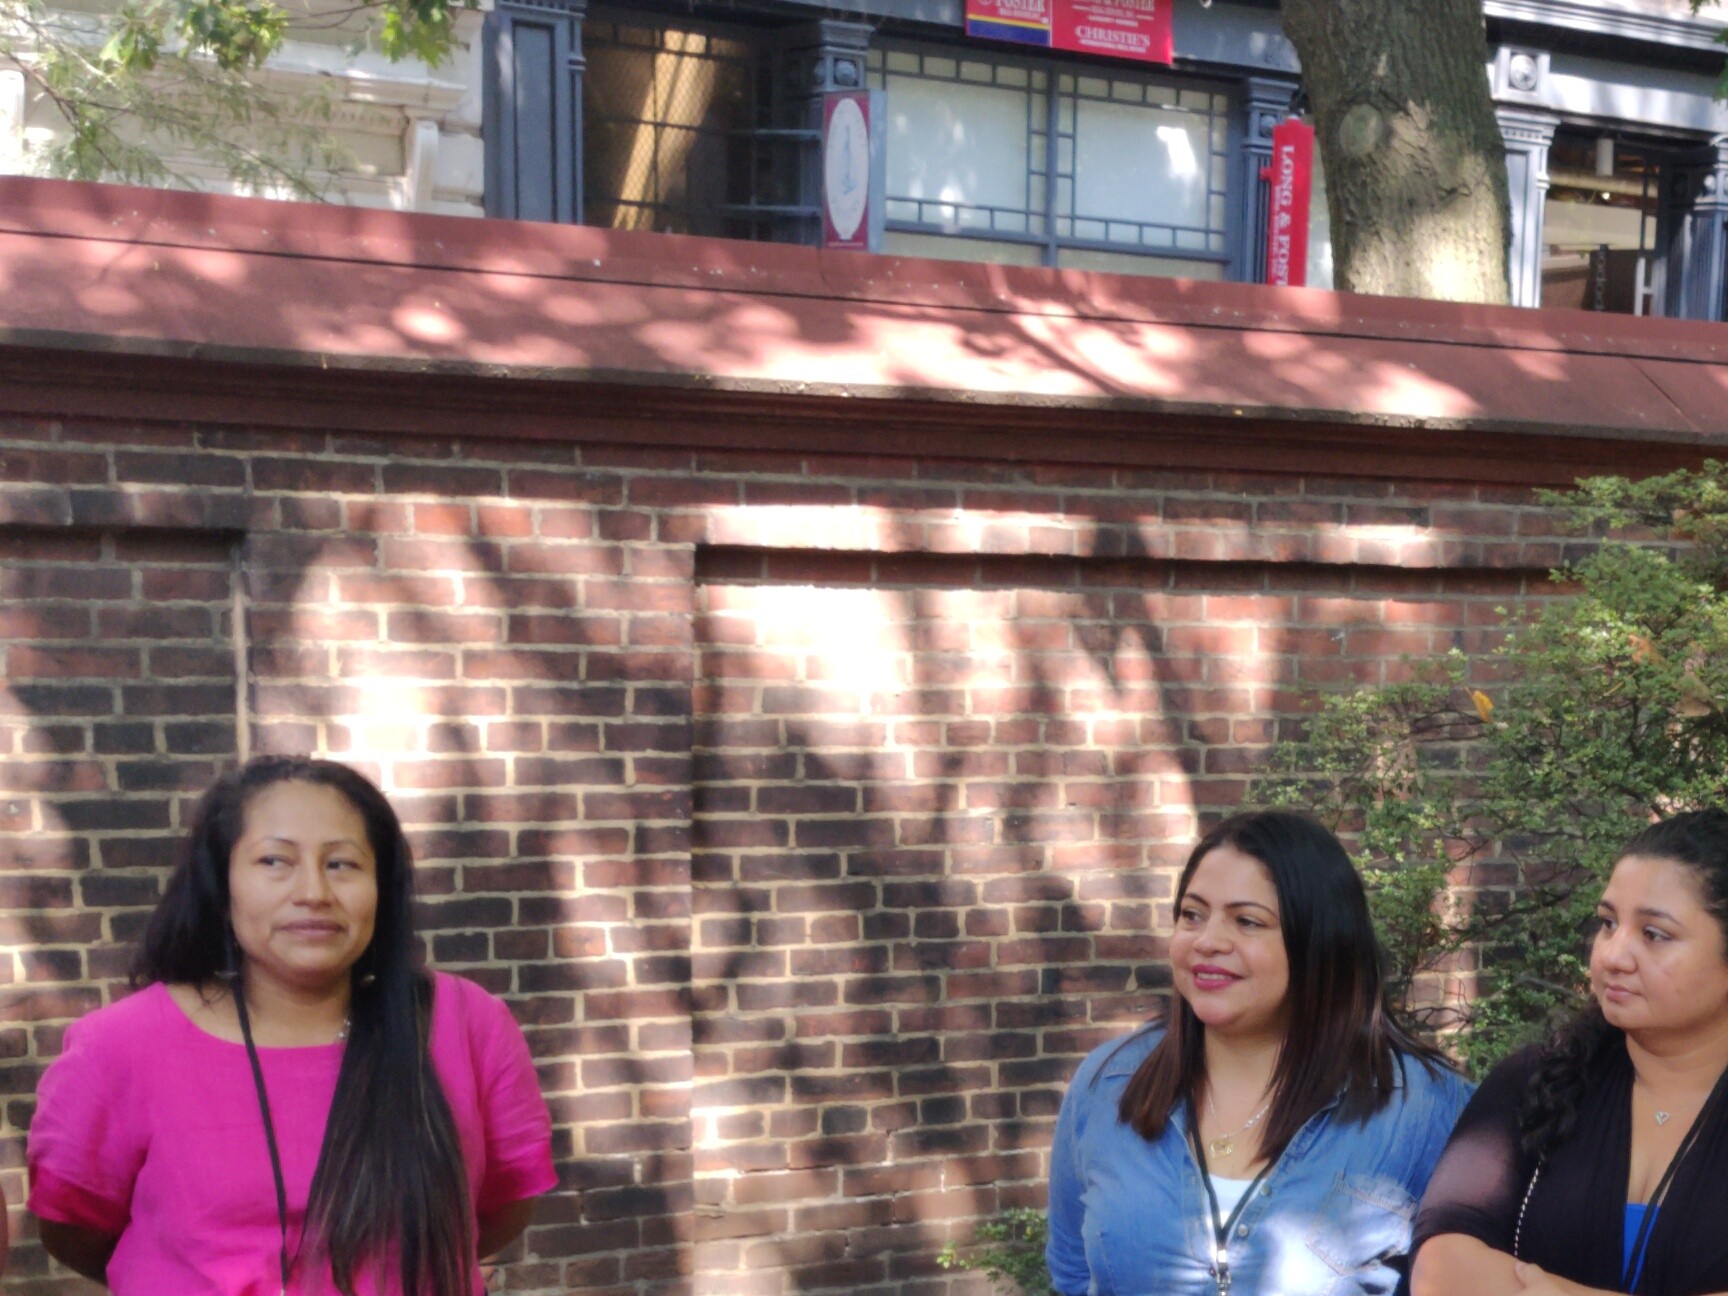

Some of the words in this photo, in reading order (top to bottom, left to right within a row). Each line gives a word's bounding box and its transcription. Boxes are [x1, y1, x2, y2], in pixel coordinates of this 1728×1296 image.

[1075, 26, 1151, 48] CHRISTIE'S
[1280, 145, 1295, 206] LONG
[1279, 211, 1292, 229] &
